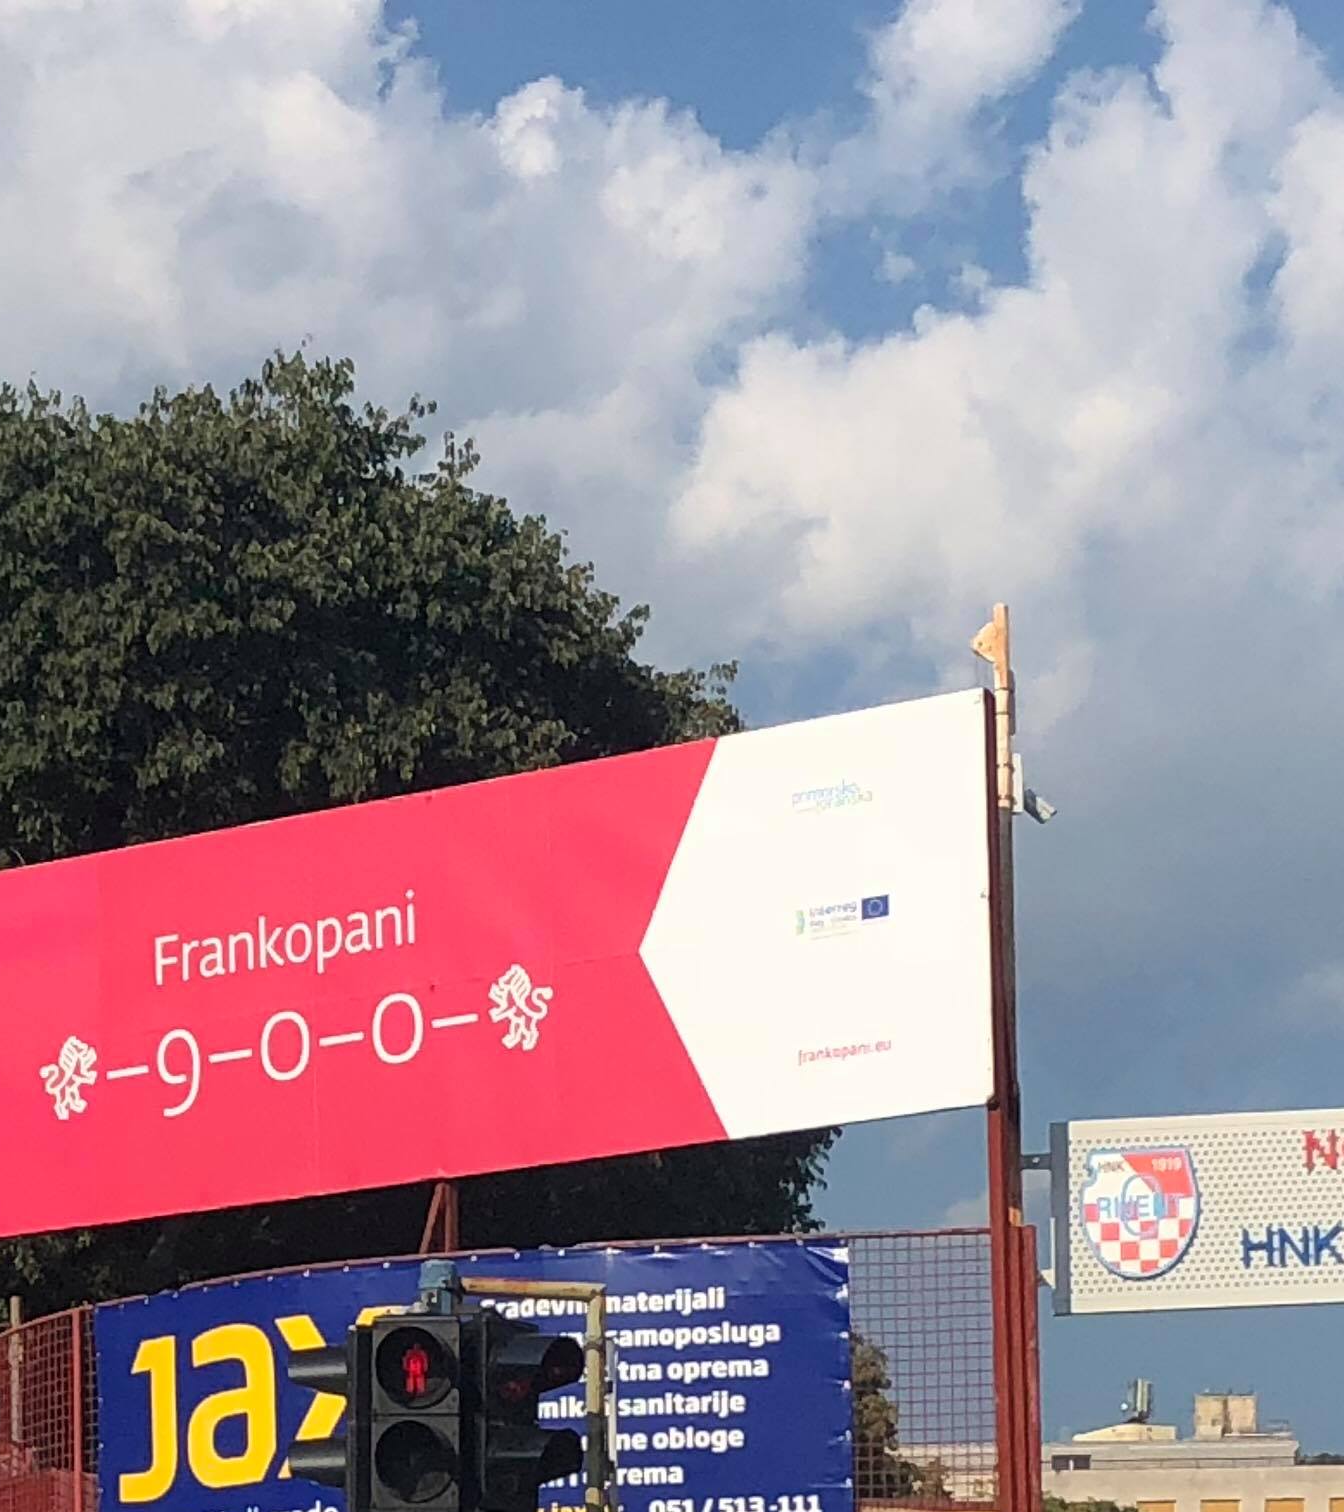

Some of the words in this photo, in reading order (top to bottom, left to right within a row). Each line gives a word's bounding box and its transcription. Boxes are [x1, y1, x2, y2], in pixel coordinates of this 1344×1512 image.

[154, 889, 416, 985] Frankopani
[798, 1040, 891, 1066] frankopani.eu
[606, 1286, 725, 1316] materijali
[606, 1320, 780, 1350] samoposluga
[667, 1358, 769, 1384] oprema
[618, 1391, 746, 1418] sanitarije
[652, 1427, 745, 1453] obloge
